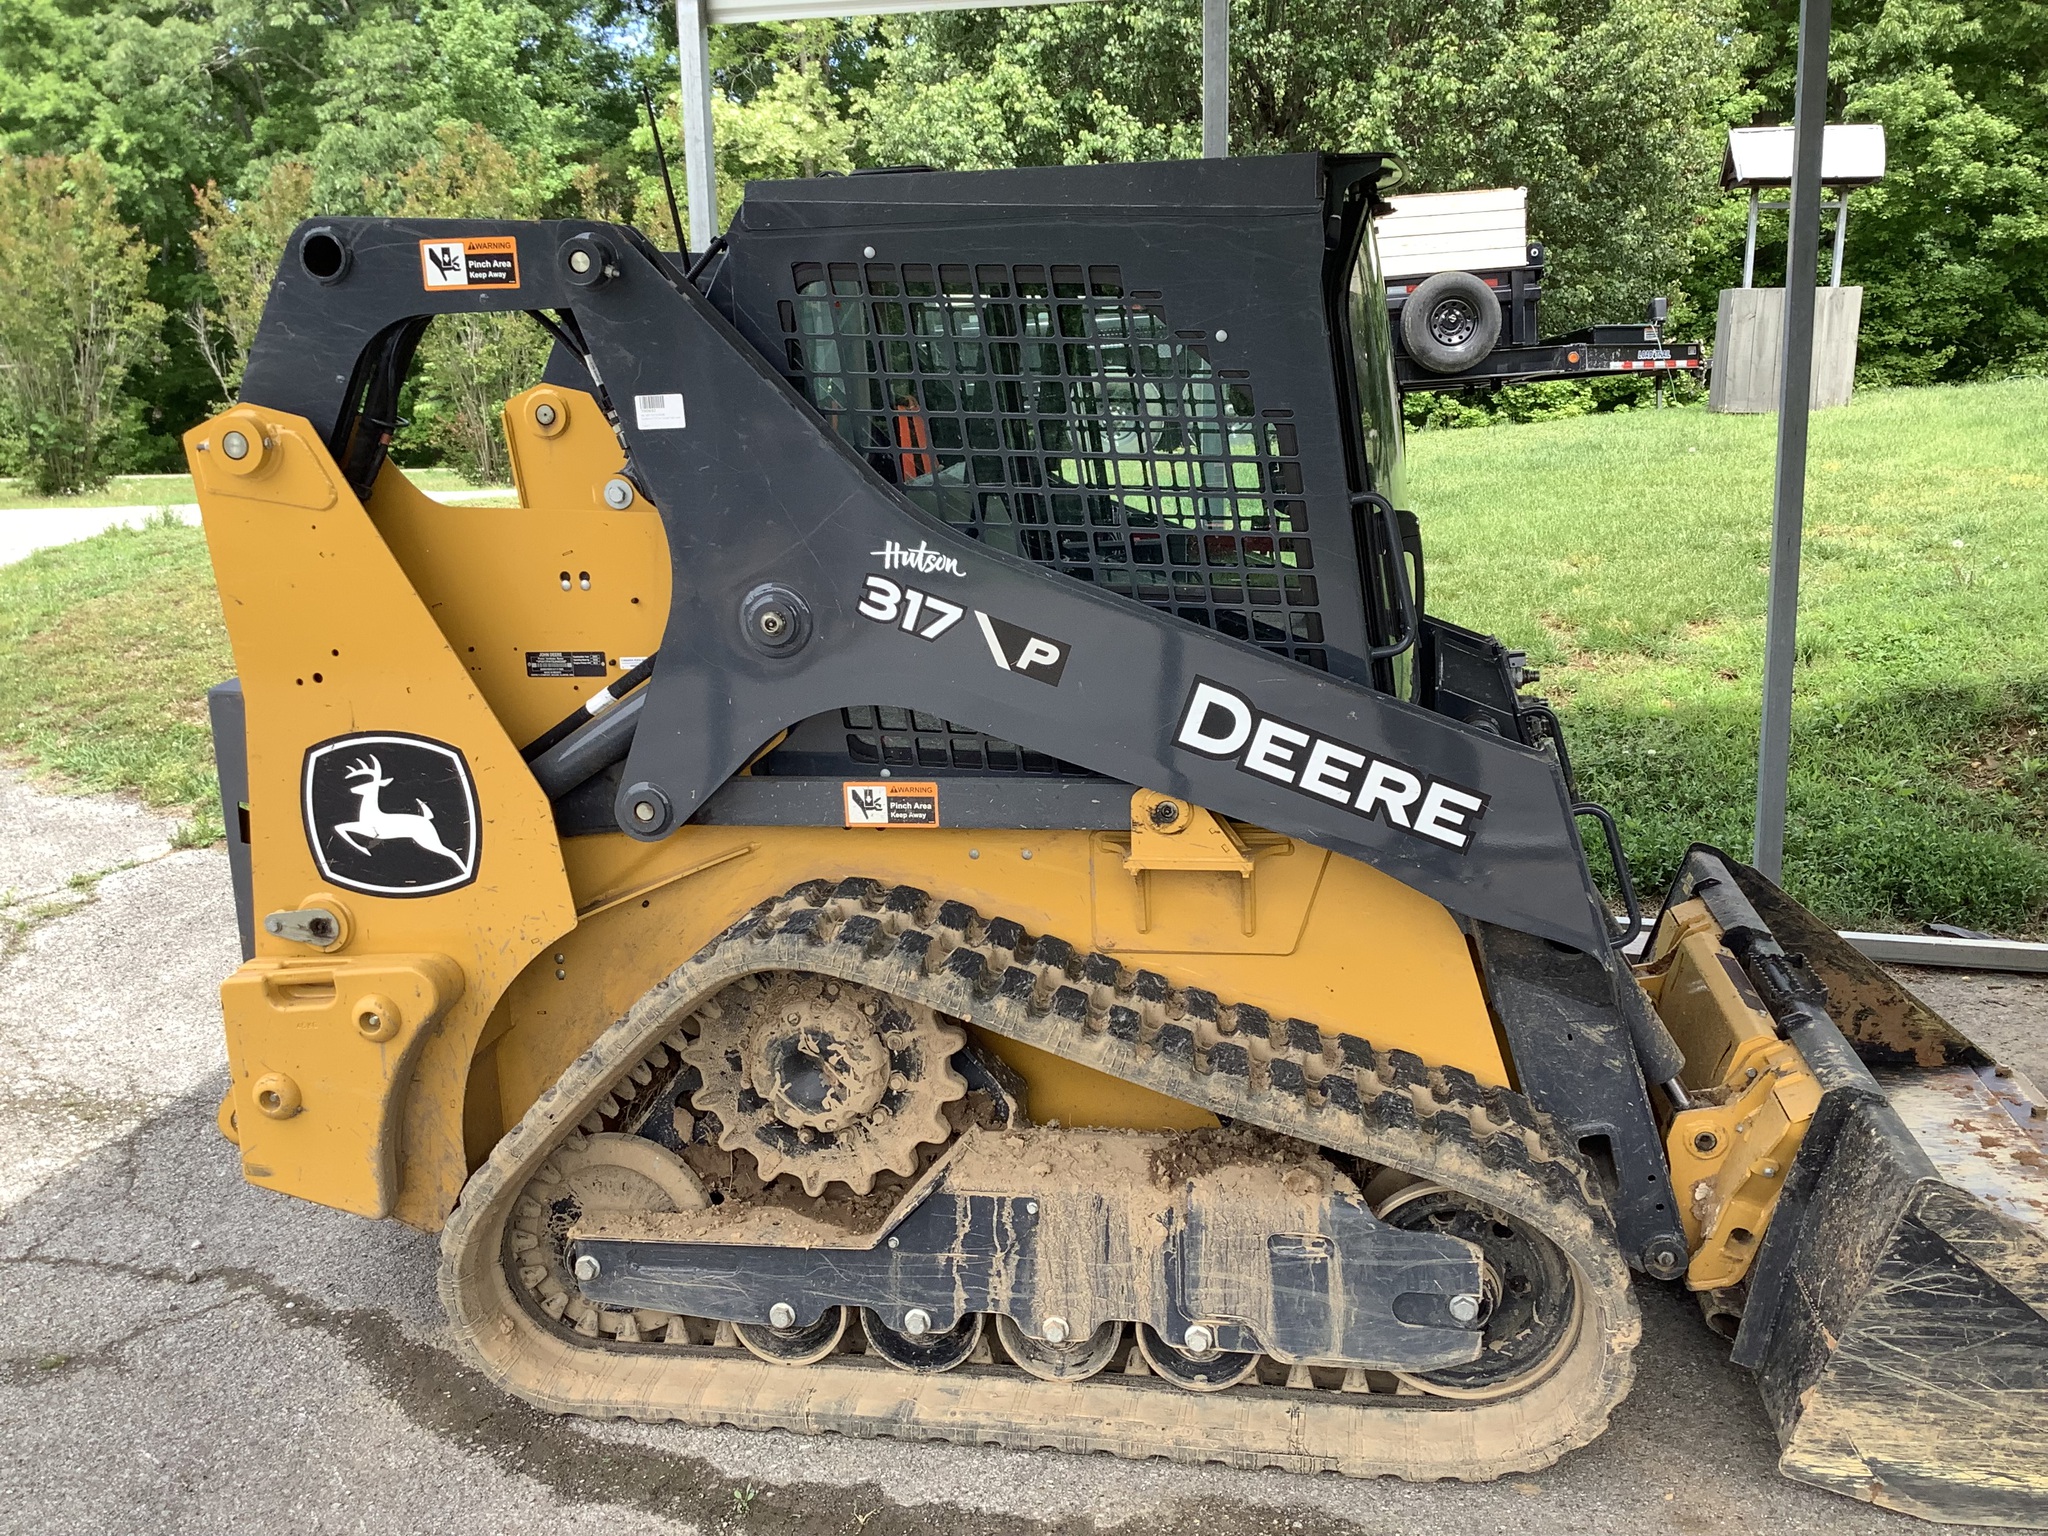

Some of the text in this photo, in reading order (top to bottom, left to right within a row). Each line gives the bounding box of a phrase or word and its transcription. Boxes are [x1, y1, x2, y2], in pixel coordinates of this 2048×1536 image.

[475, 242, 511, 250] WARNING
[468, 260, 512, 268] Pinch Area
[469, 271, 507, 279] Keep Away
[870, 540, 967, 577] Hutson
[858, 575, 965, 640] 317
[1178, 682, 1483, 848] DEERE
